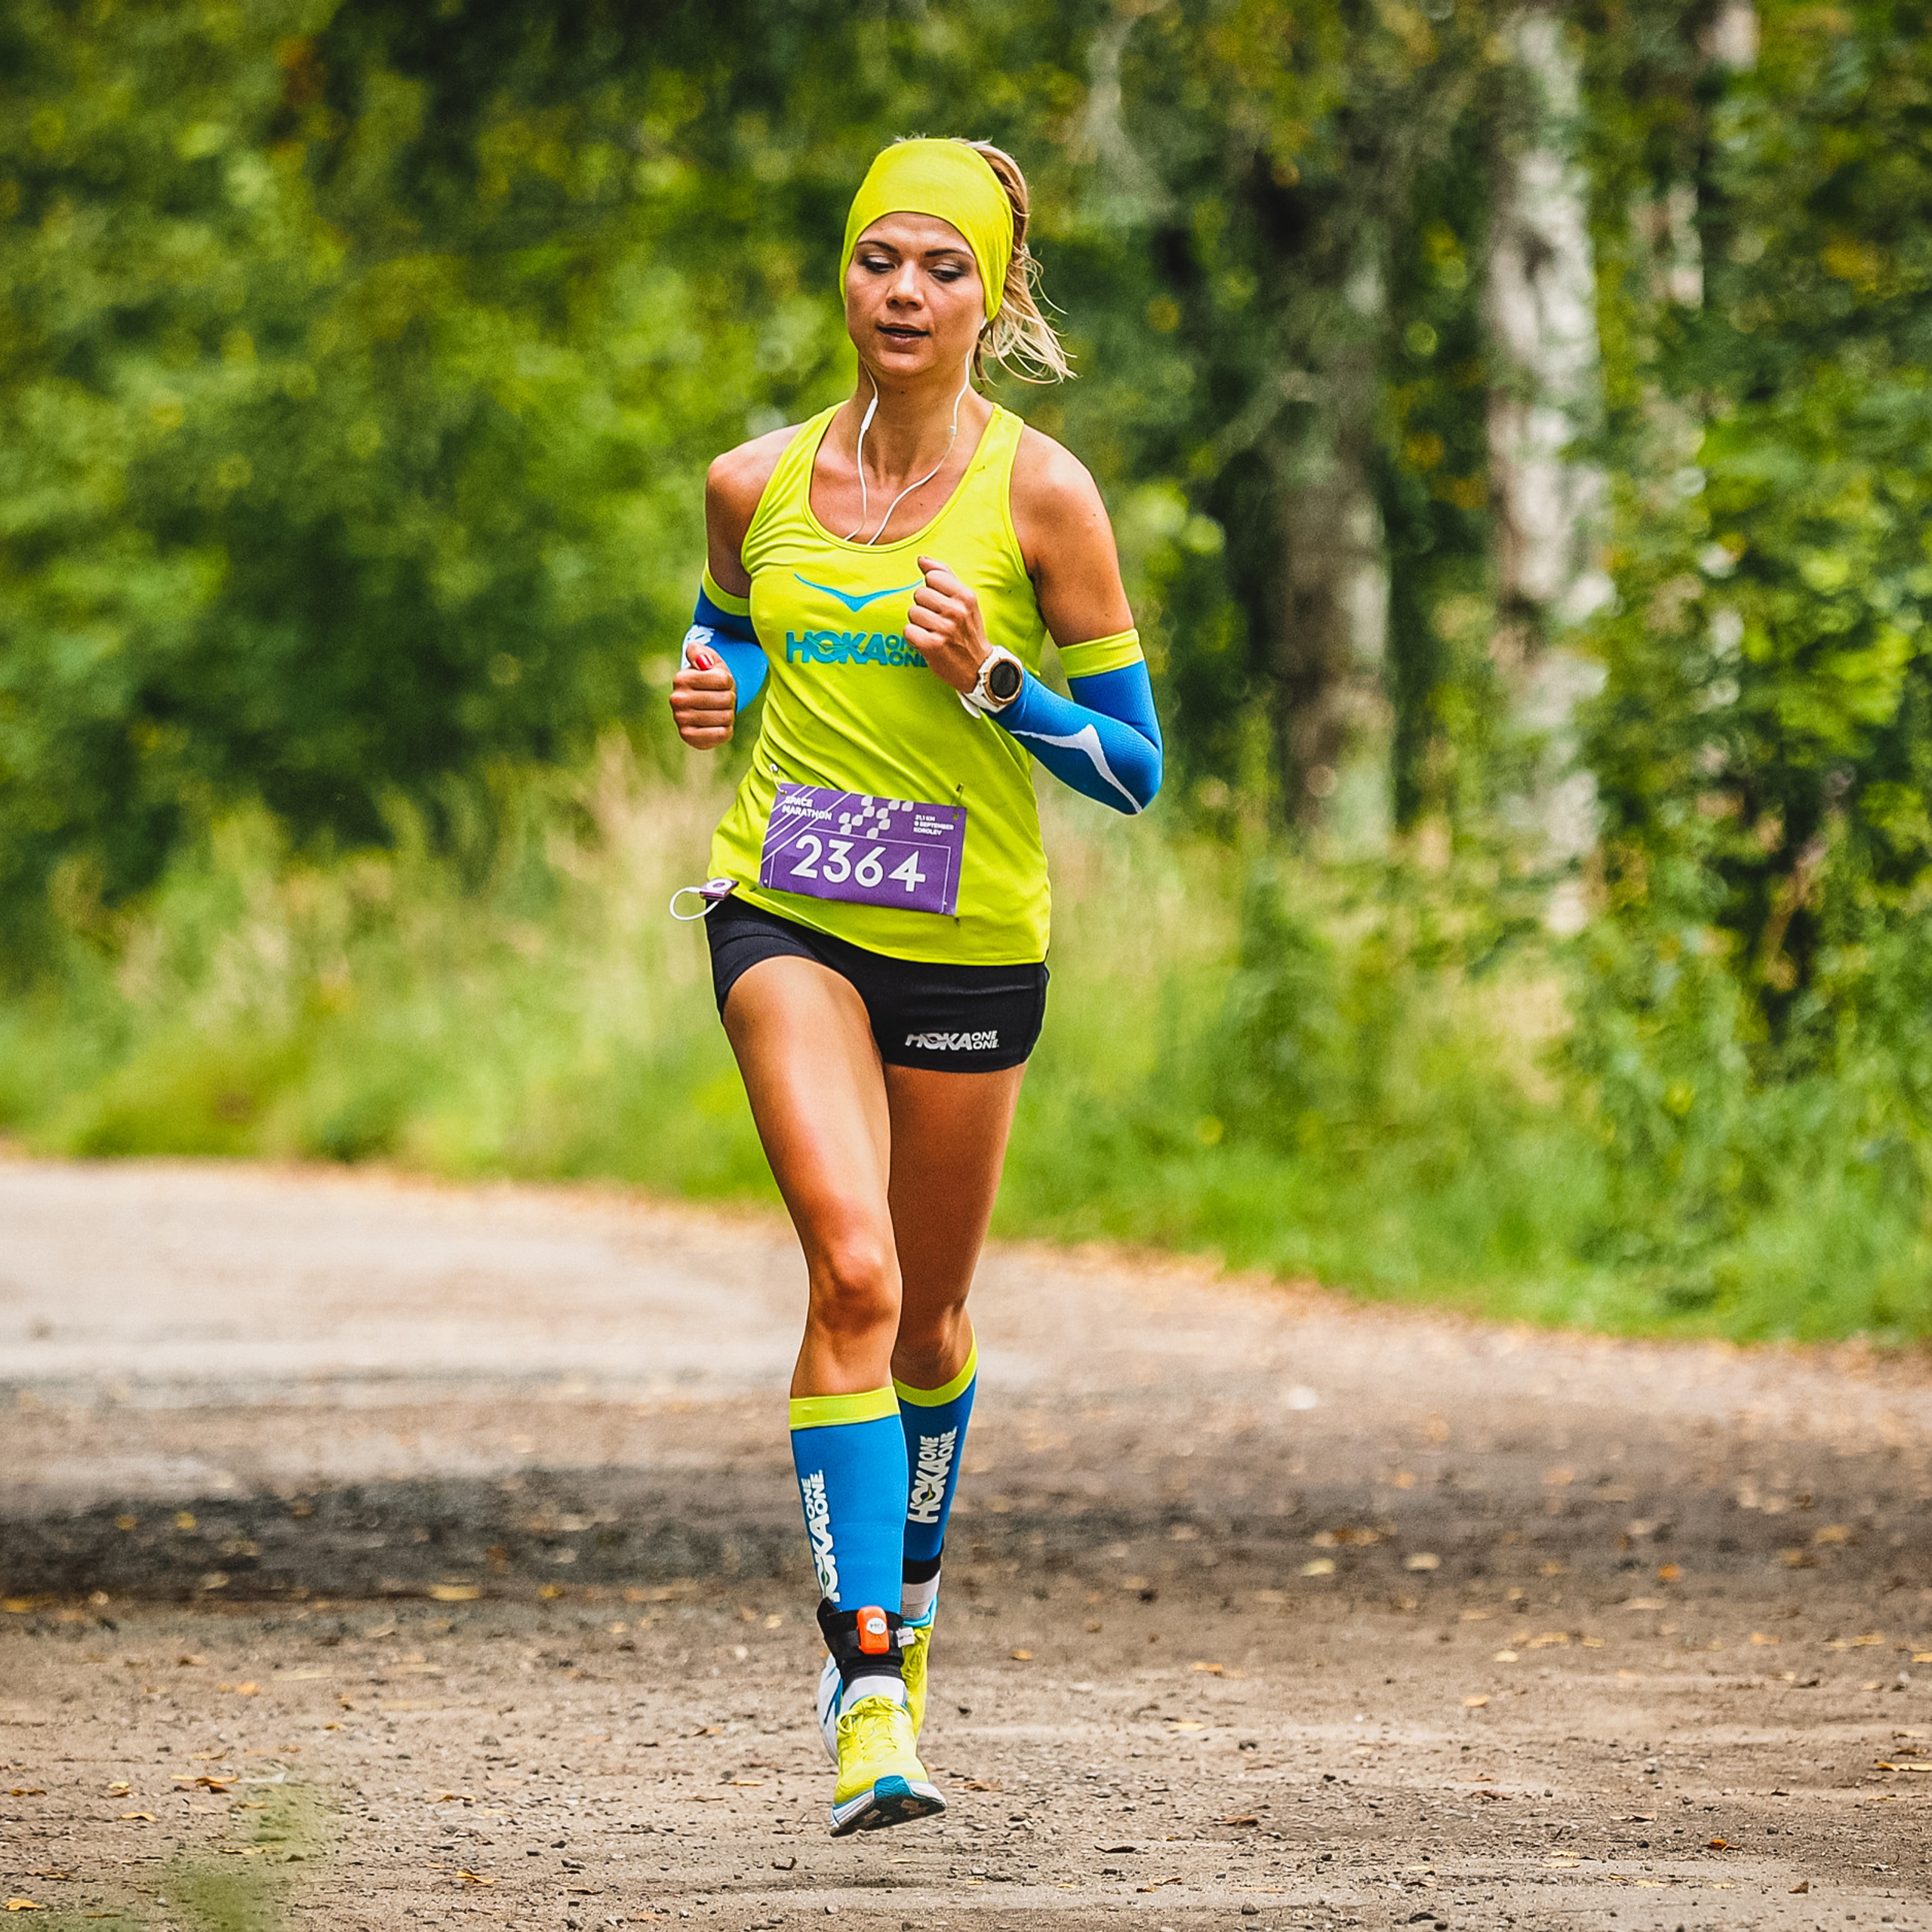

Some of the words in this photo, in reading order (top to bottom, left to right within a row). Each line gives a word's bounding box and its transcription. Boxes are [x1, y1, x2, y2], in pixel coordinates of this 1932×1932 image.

[786, 630, 888, 666] HOKA
[782, 804, 832, 821] MARATHON
[785, 795, 814, 808] SPACE
[919, 821, 955, 831] SEPTEMBER
[789, 834, 927, 893] 2364
[905, 1032, 973, 1051] HOKA
[971, 1030, 998, 1041] ONE
[918, 1435, 940, 1461] ONE
[801, 1477, 816, 1520] ONE
[907, 1454, 952, 1524] HOKA
